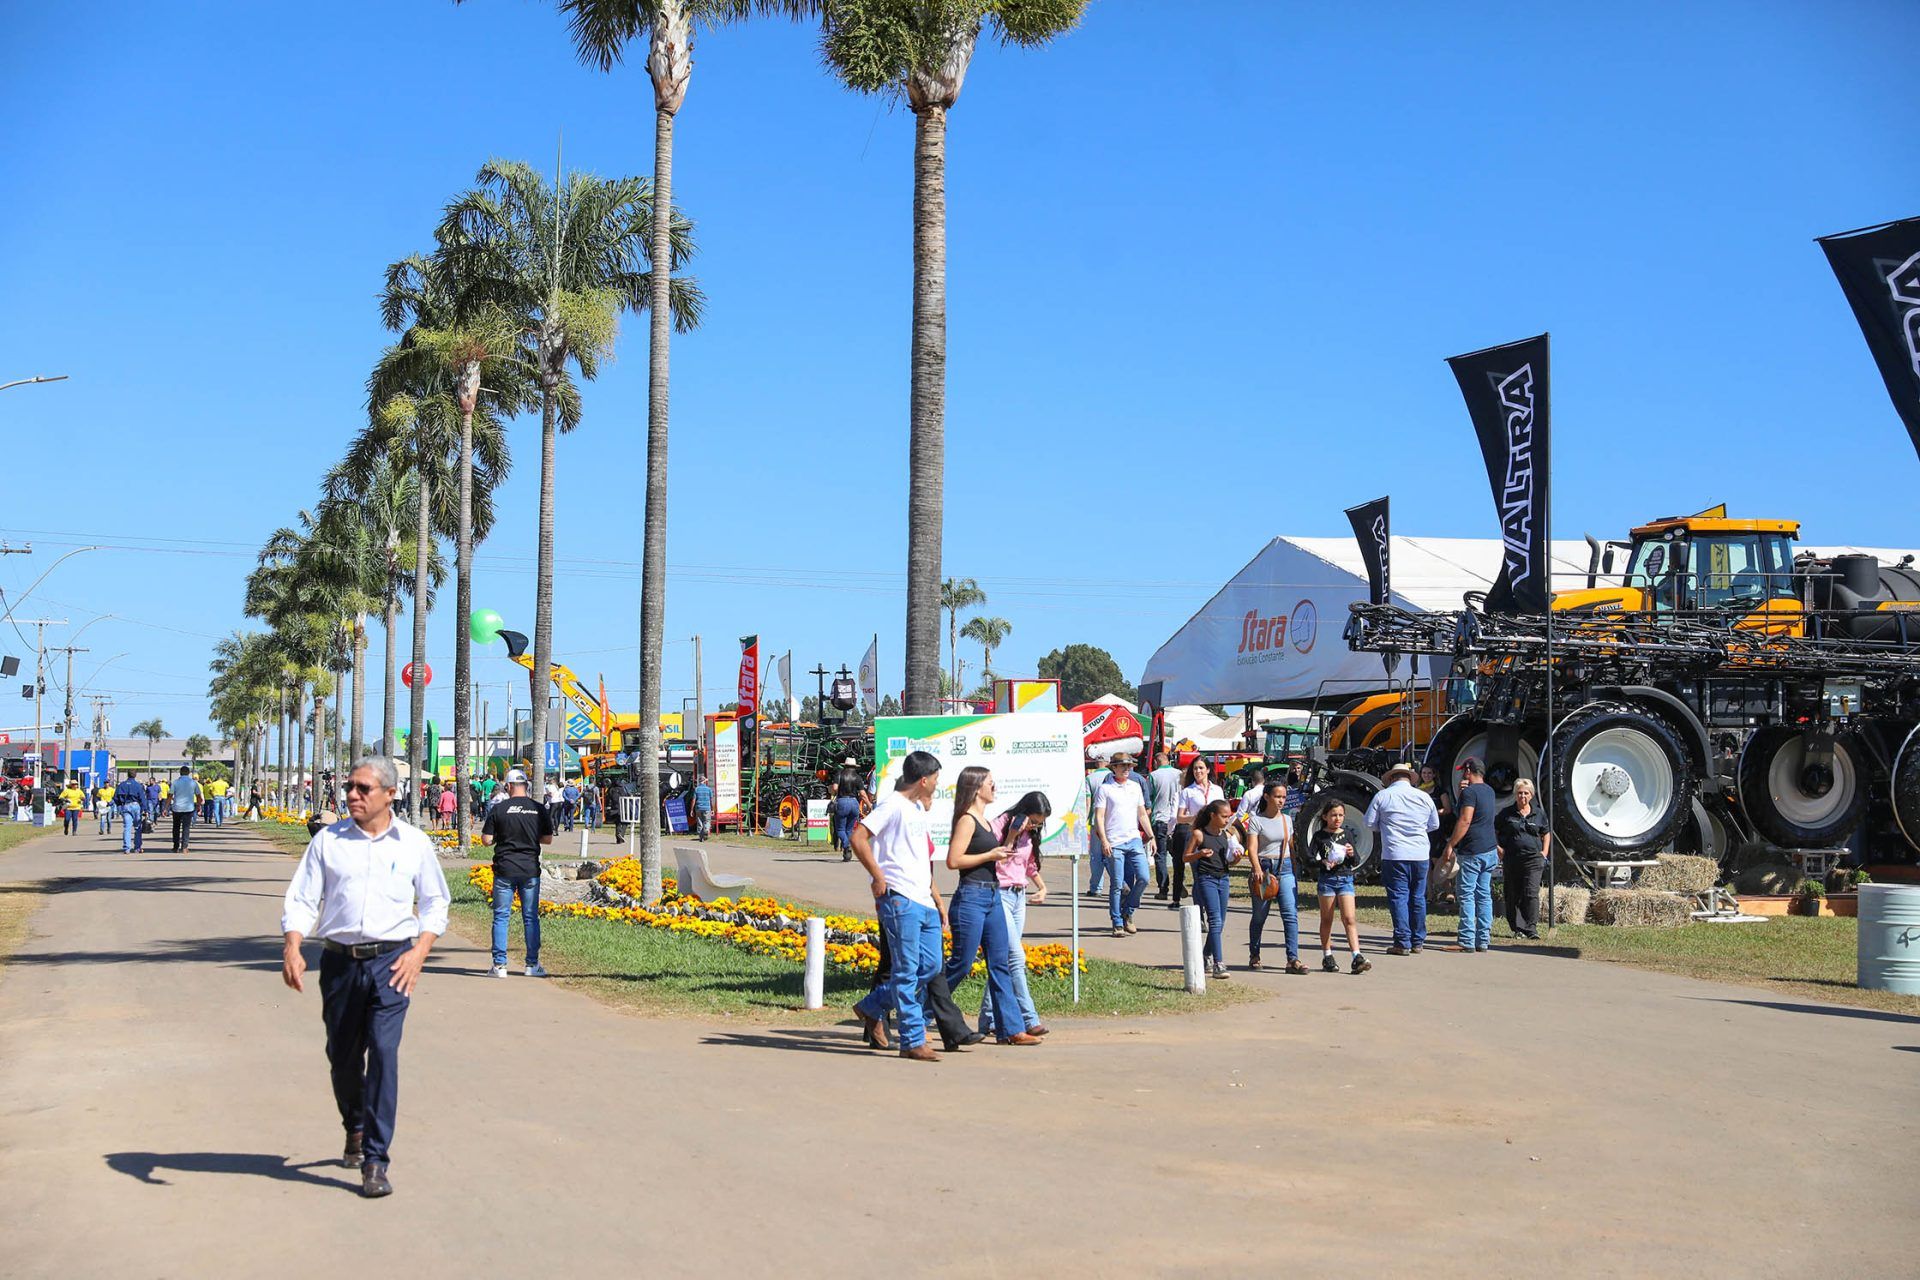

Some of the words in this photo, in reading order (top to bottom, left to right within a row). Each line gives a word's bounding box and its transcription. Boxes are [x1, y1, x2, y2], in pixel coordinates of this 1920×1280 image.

[1498, 362, 1534, 592] VALTRA
[1238, 608, 1288, 653] Stara
[739, 654, 755, 712] Stara
[572, 694, 592, 714] JCB
[664, 725, 681, 734] SIL
[1089, 715, 1105, 729] TUDO
[950, 736, 967, 751] 15
